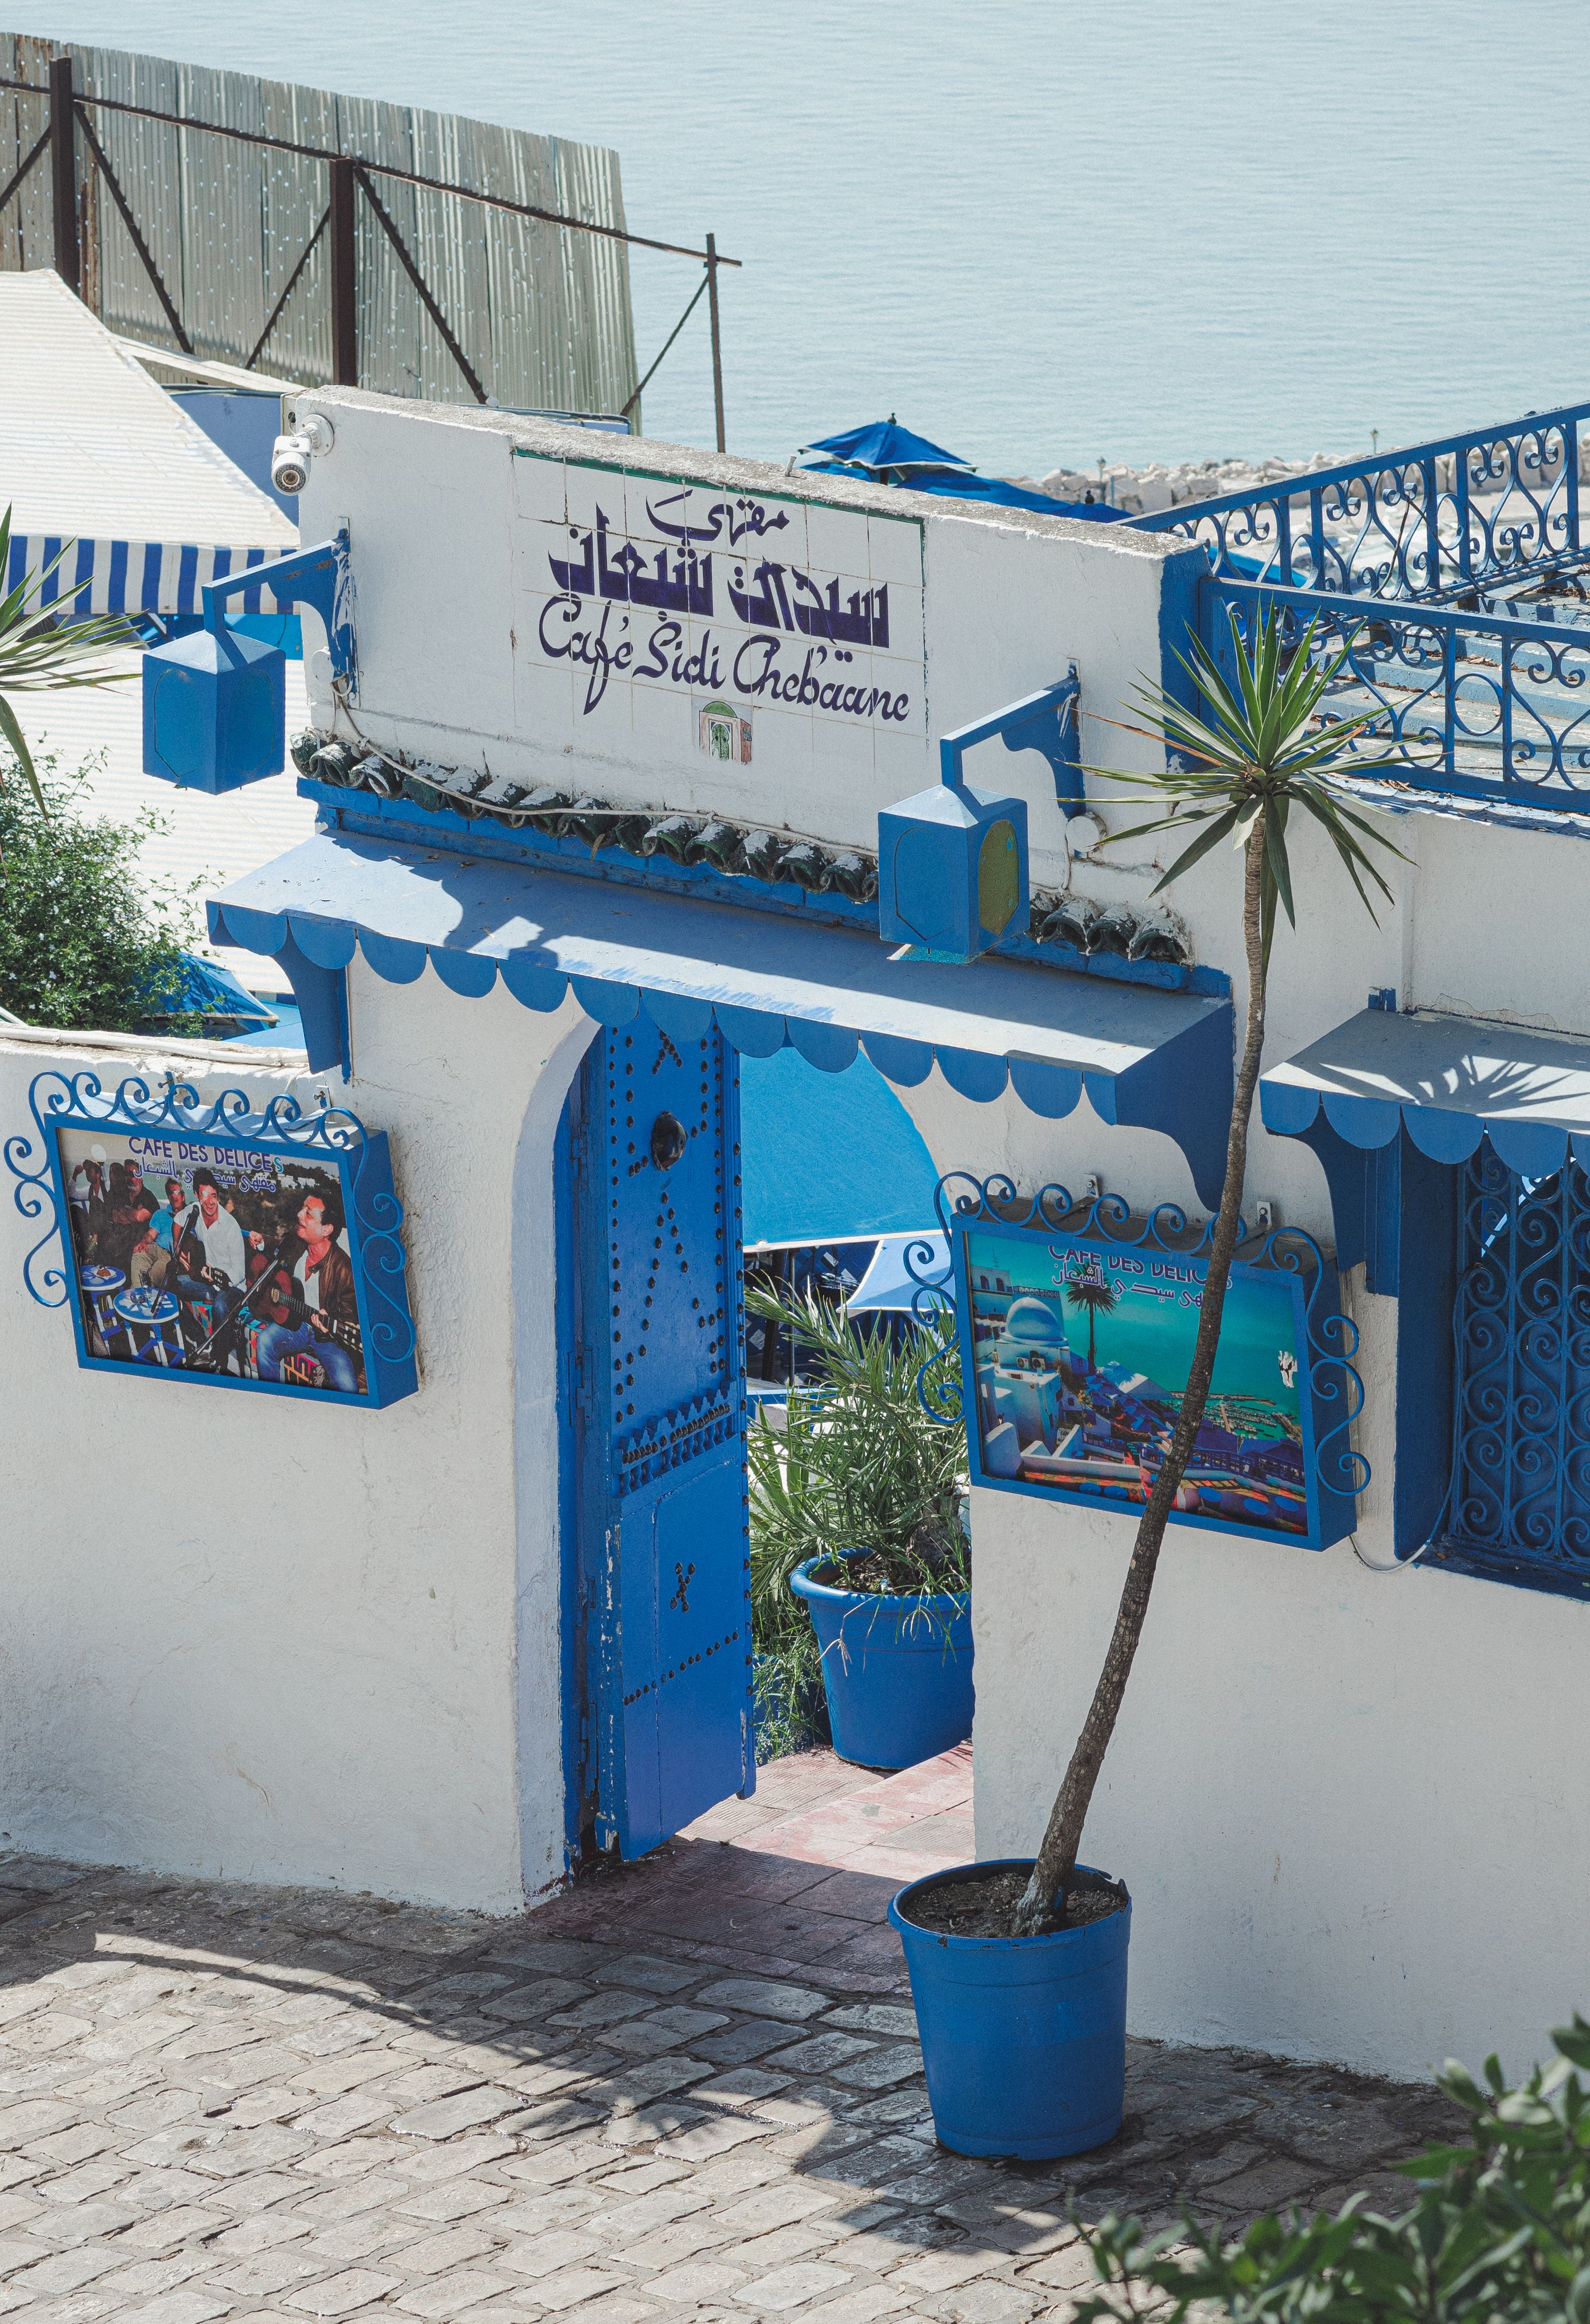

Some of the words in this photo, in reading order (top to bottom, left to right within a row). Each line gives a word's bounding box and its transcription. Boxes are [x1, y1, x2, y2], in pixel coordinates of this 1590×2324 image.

[632, 621, 726, 689] Sidi
[129, 1136, 172, 1158] CAFE
[178, 1142, 208, 1162] DES
[213, 1146, 283, 1173] DELICES
[1048, 1245, 1101, 1267] CAFE
[1108, 1255, 1144, 1274] DES
